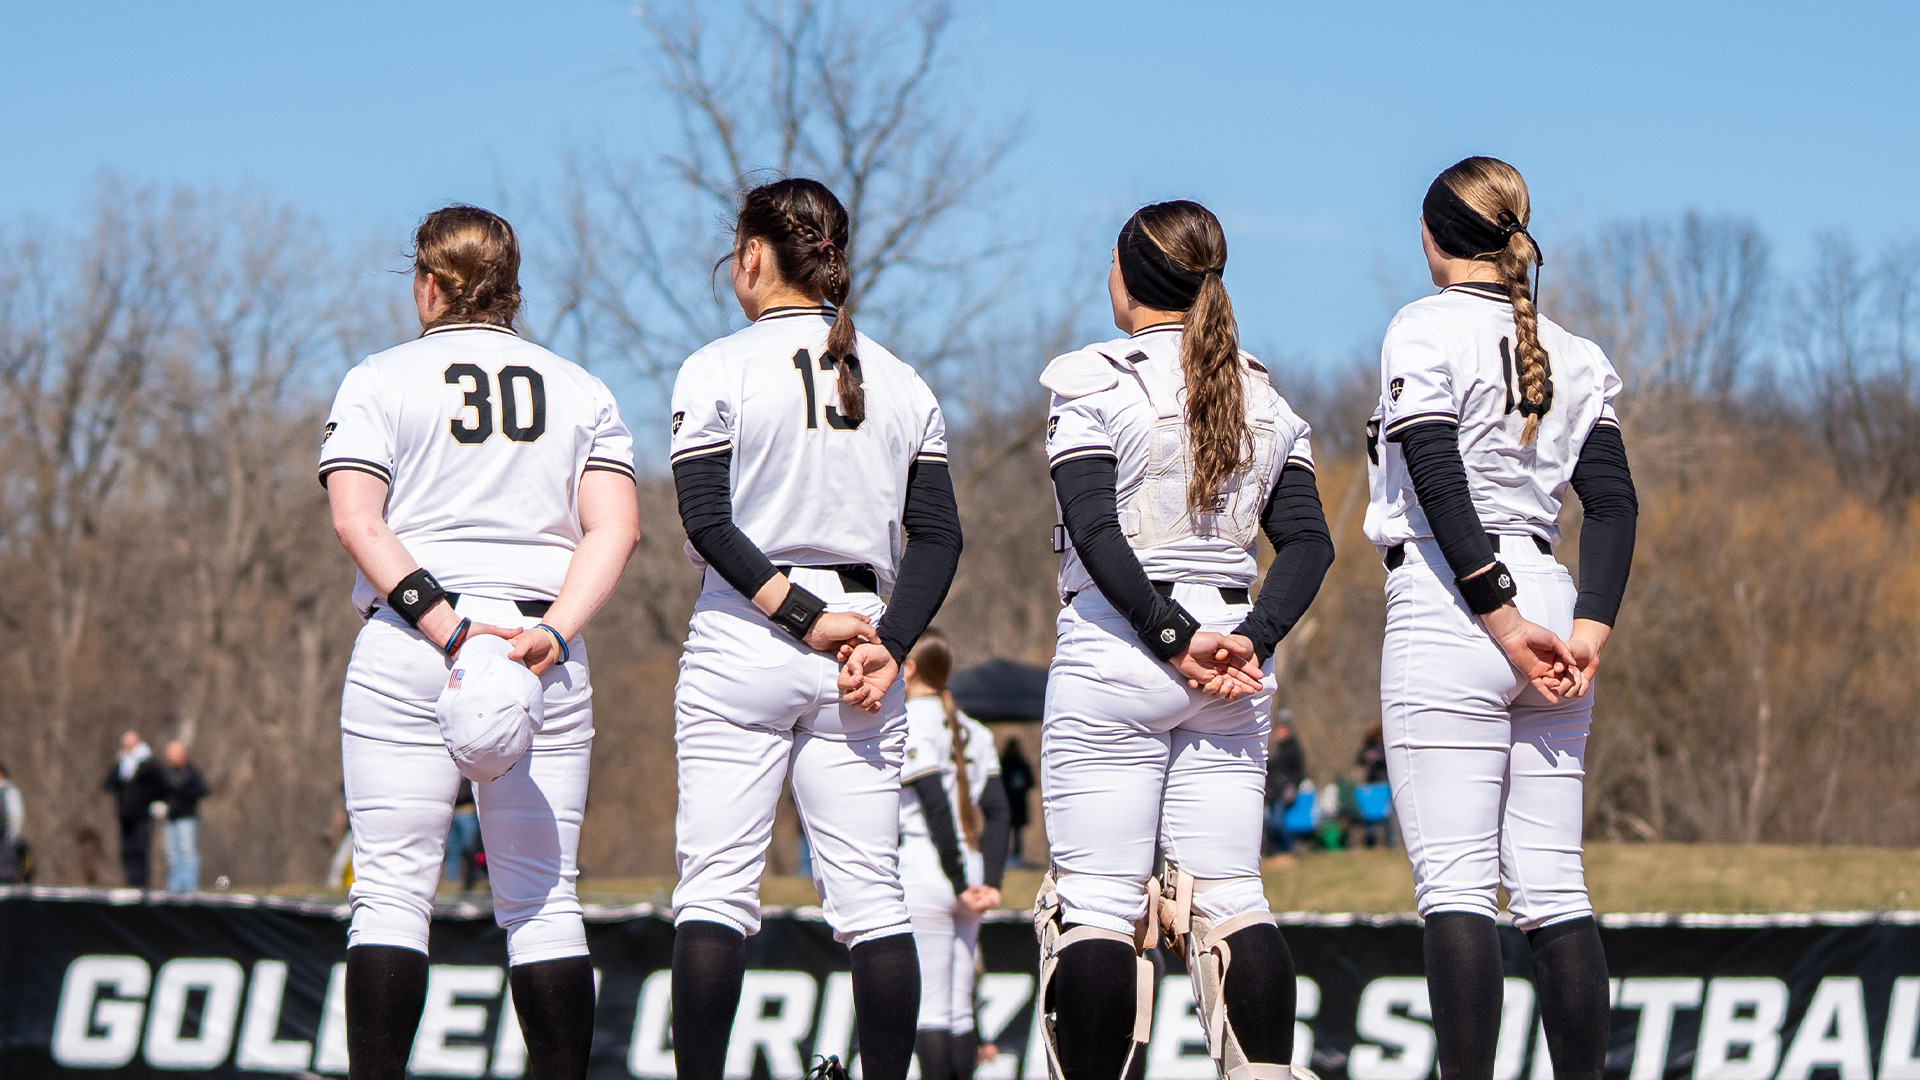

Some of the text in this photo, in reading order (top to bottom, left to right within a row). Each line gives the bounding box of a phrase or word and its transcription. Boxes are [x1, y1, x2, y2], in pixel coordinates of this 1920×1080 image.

[444, 361, 548, 446] 30
[791, 347, 867, 432] 13
[1346, 975, 1920, 1080] STBAL
